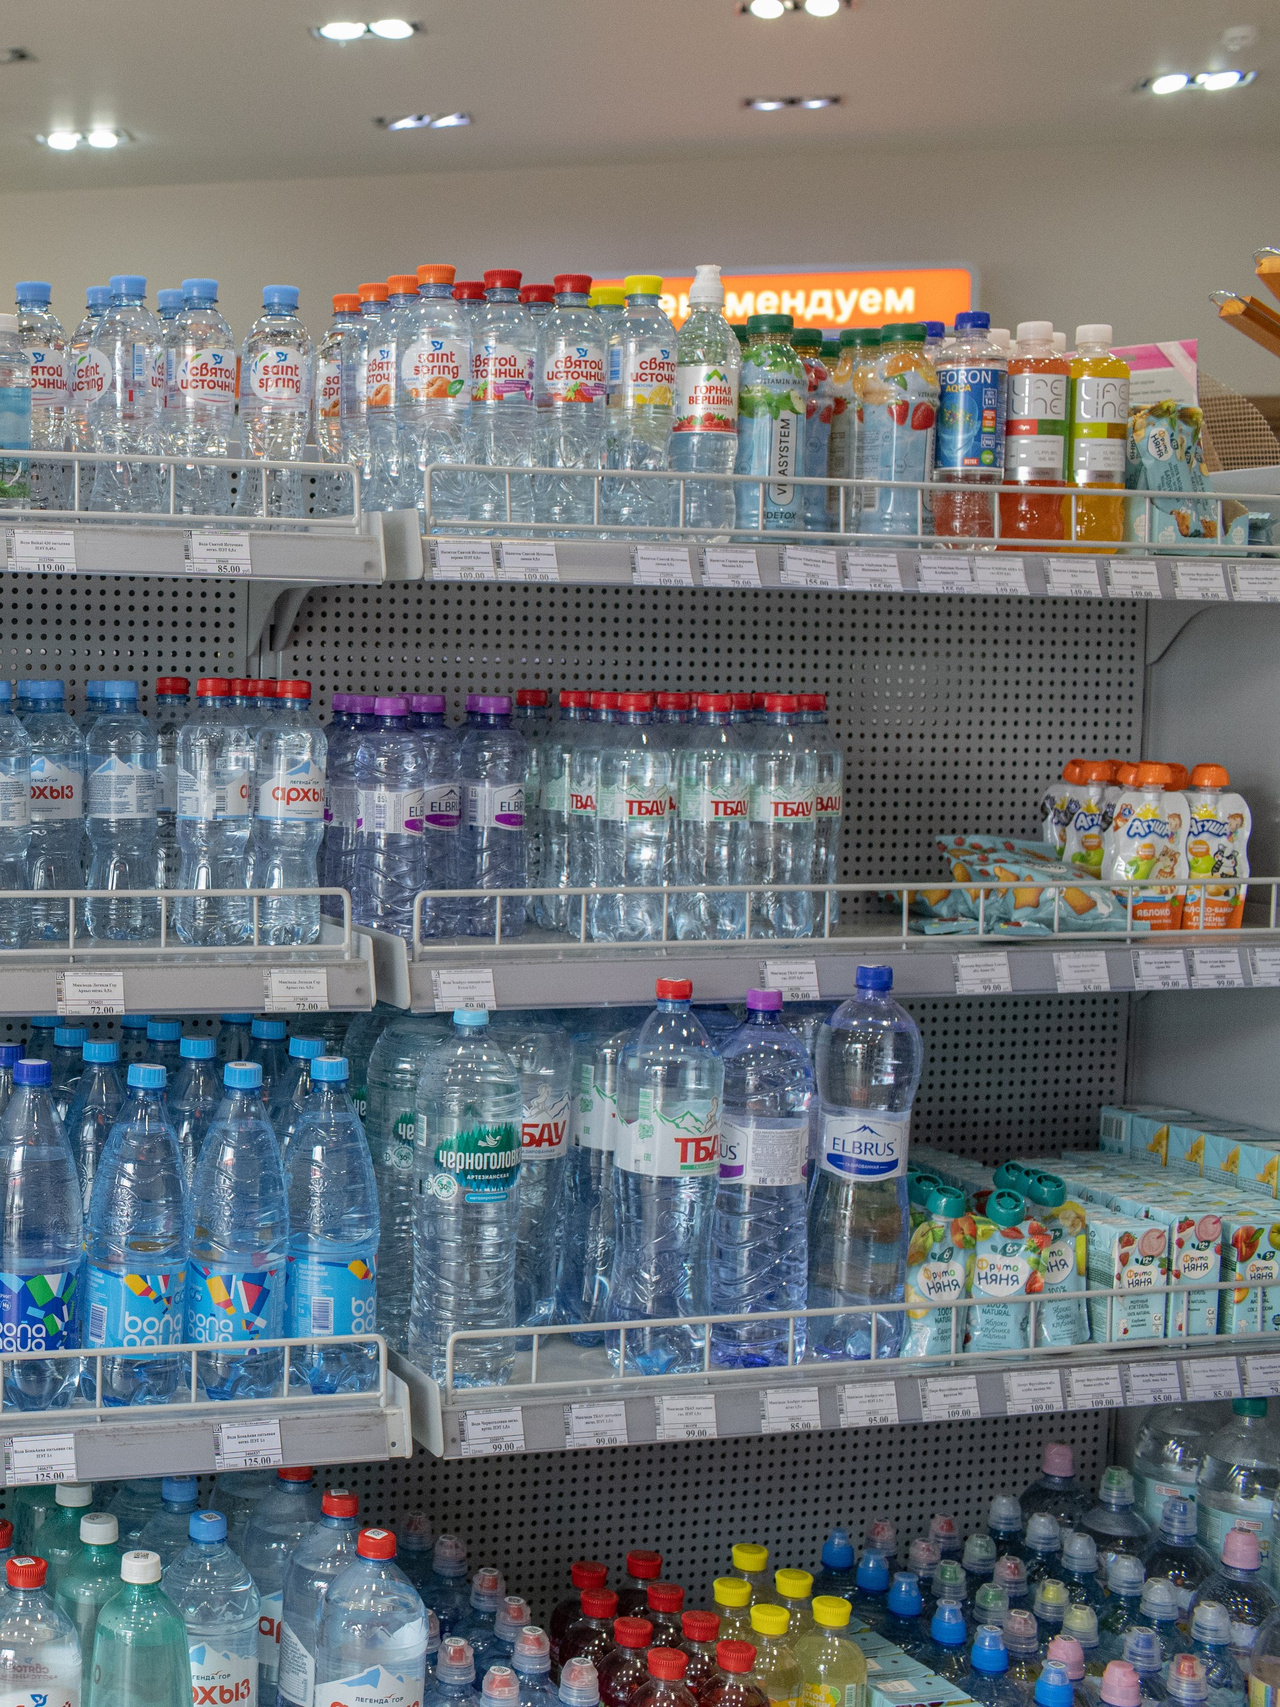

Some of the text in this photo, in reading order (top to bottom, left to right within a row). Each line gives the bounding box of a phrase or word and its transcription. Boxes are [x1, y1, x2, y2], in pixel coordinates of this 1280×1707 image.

[418, 350, 456, 364] saint
[554, 356, 604, 371] святой
[639, 358, 676, 371] свято
[190, 361, 235, 377] святой
[262, 363, 299, 376] saint
[413, 364, 459, 379] spring
[258, 376, 301, 392] spring
[945, 384, 972, 393] AQUA
[694, 385, 732, 396] ГОРНАЯ
[688, 395, 734, 406] ВЕРШИНА
[217, 564, 241, 574] 85.00
[626, 800, 666, 816] ТБАУ
[710, 801, 748, 816] ТБАУ
[770, 801, 813, 817] ТБАУ
[1136, 908, 1170, 918] ЯБЛОКО
[982, 984, 1002, 992] 99.00
[1162, 980, 1180, 988] 99.00
[1216, 980, 1235, 988] 99.00
[91, 1005, 114, 1014] 72.00
[295, 1002, 318, 1011] 72.00
[522, 1120, 566, 1147] БАУ
[833, 1138, 895, 1156] ELBRUS
[467, 1172, 510, 1180] АРТЕЗИАНСКАЯ
[1183, 1262, 1209, 1273] НЯНЯ
[977, 1272, 1020, 1286] НЯНЯ
[1127, 1278, 1153, 1288] НЯНЯ
[926, 1278, 961, 1296] НЯНЯ
[981, 1309, 1011, 1317] NATURAL
[984, 1319, 1008, 1328] Яблоко
[1090, 1399, 1114, 1408] 109.00
[1153, 1394, 1173, 1403] 85.00
[1030, 1404, 1054, 1413] 109.00
[947, 1409, 971, 1419] 109.00
[868, 1416, 889, 1425] 95.00
[790, 1422, 811, 1431] 85.00
[686, 1429, 707, 1438] 99.00
[595, 1436, 617, 1445] 99.00
[492, 1442, 514, 1452] 99.00
[243, 1456, 271, 1466] 125.00
[35, 1471, 64, 1481] 125.00
